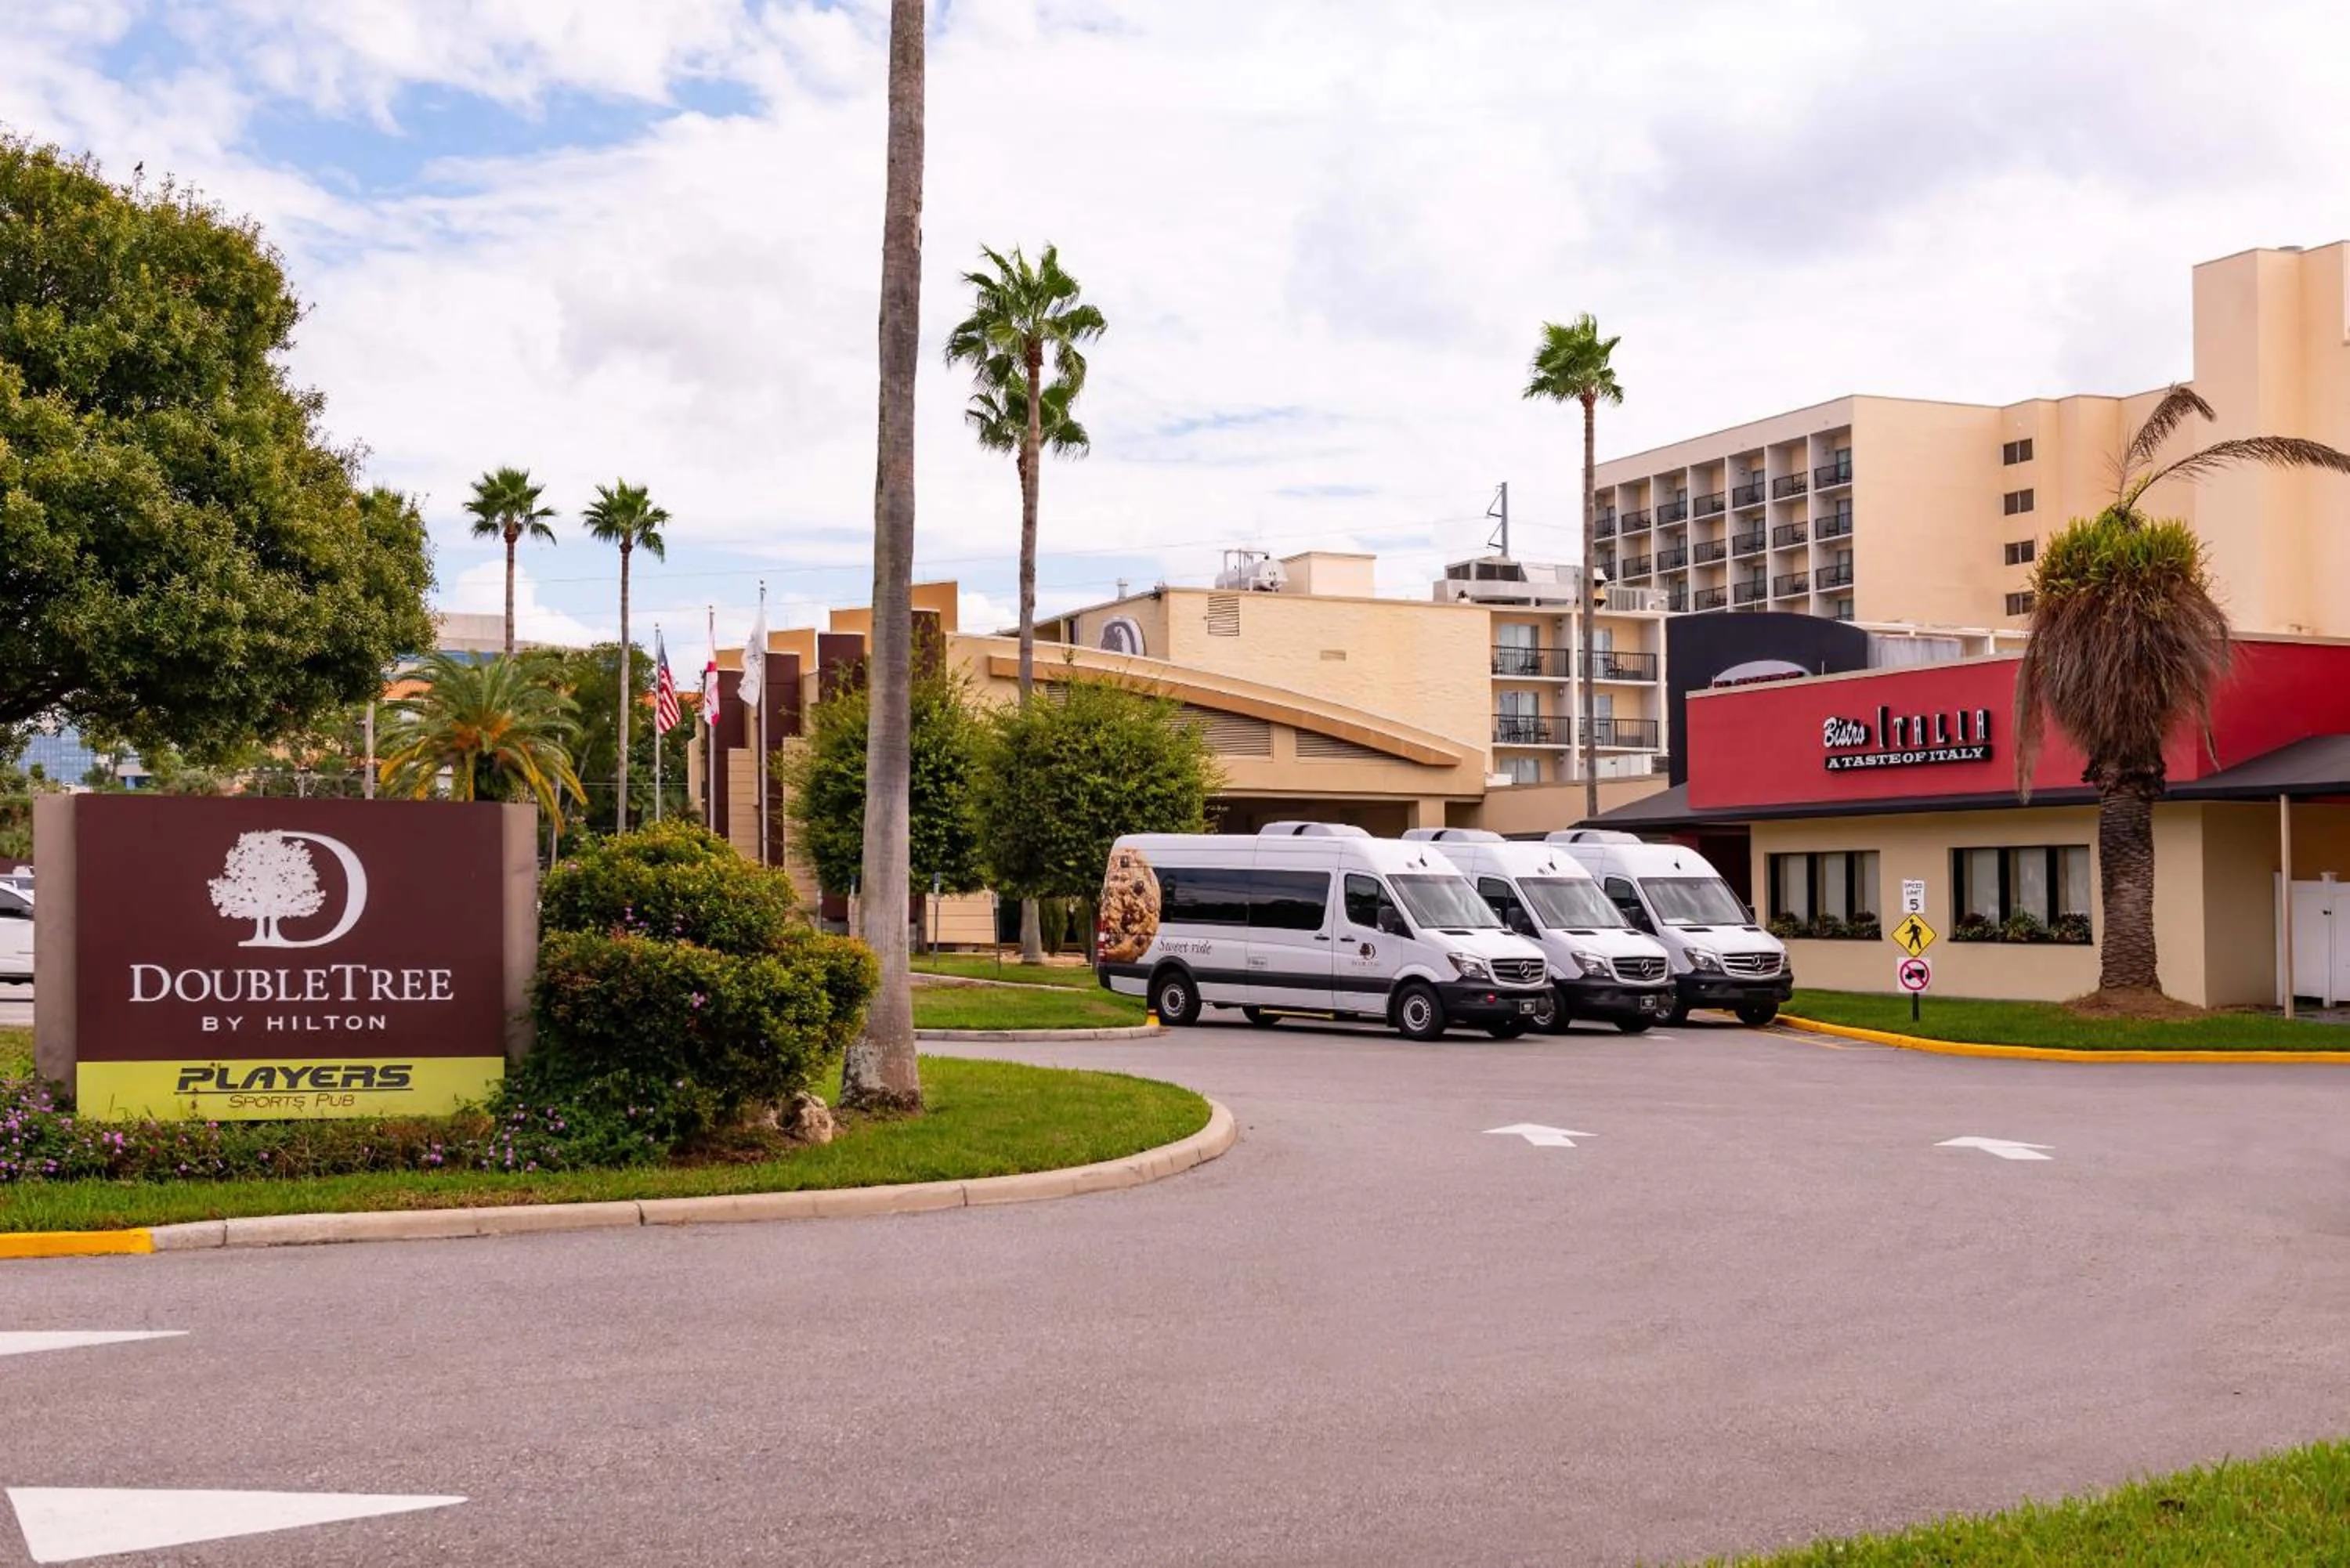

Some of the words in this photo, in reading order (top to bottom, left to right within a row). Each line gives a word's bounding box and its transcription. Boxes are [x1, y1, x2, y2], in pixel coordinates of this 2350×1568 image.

[1823, 716, 1866, 748] Bistro
[1828, 757, 1841, 769] A
[1841, 753, 1902, 768] TASTE
[1903, 750, 1928, 764] OF
[1929, 746, 1985, 761] ITALY
[1909, 898, 1919, 910] 5
[1159, 939, 1189, 953] Sweet
[1191, 940, 1212, 955] ride
[201, 1016, 244, 1031] BY
[267, 1014, 386, 1031] HILTON
[177, 1064, 414, 1091] PLAYERS
[228, 1094, 306, 1109] SPORTS
[315, 1093, 355, 1107] PUB
